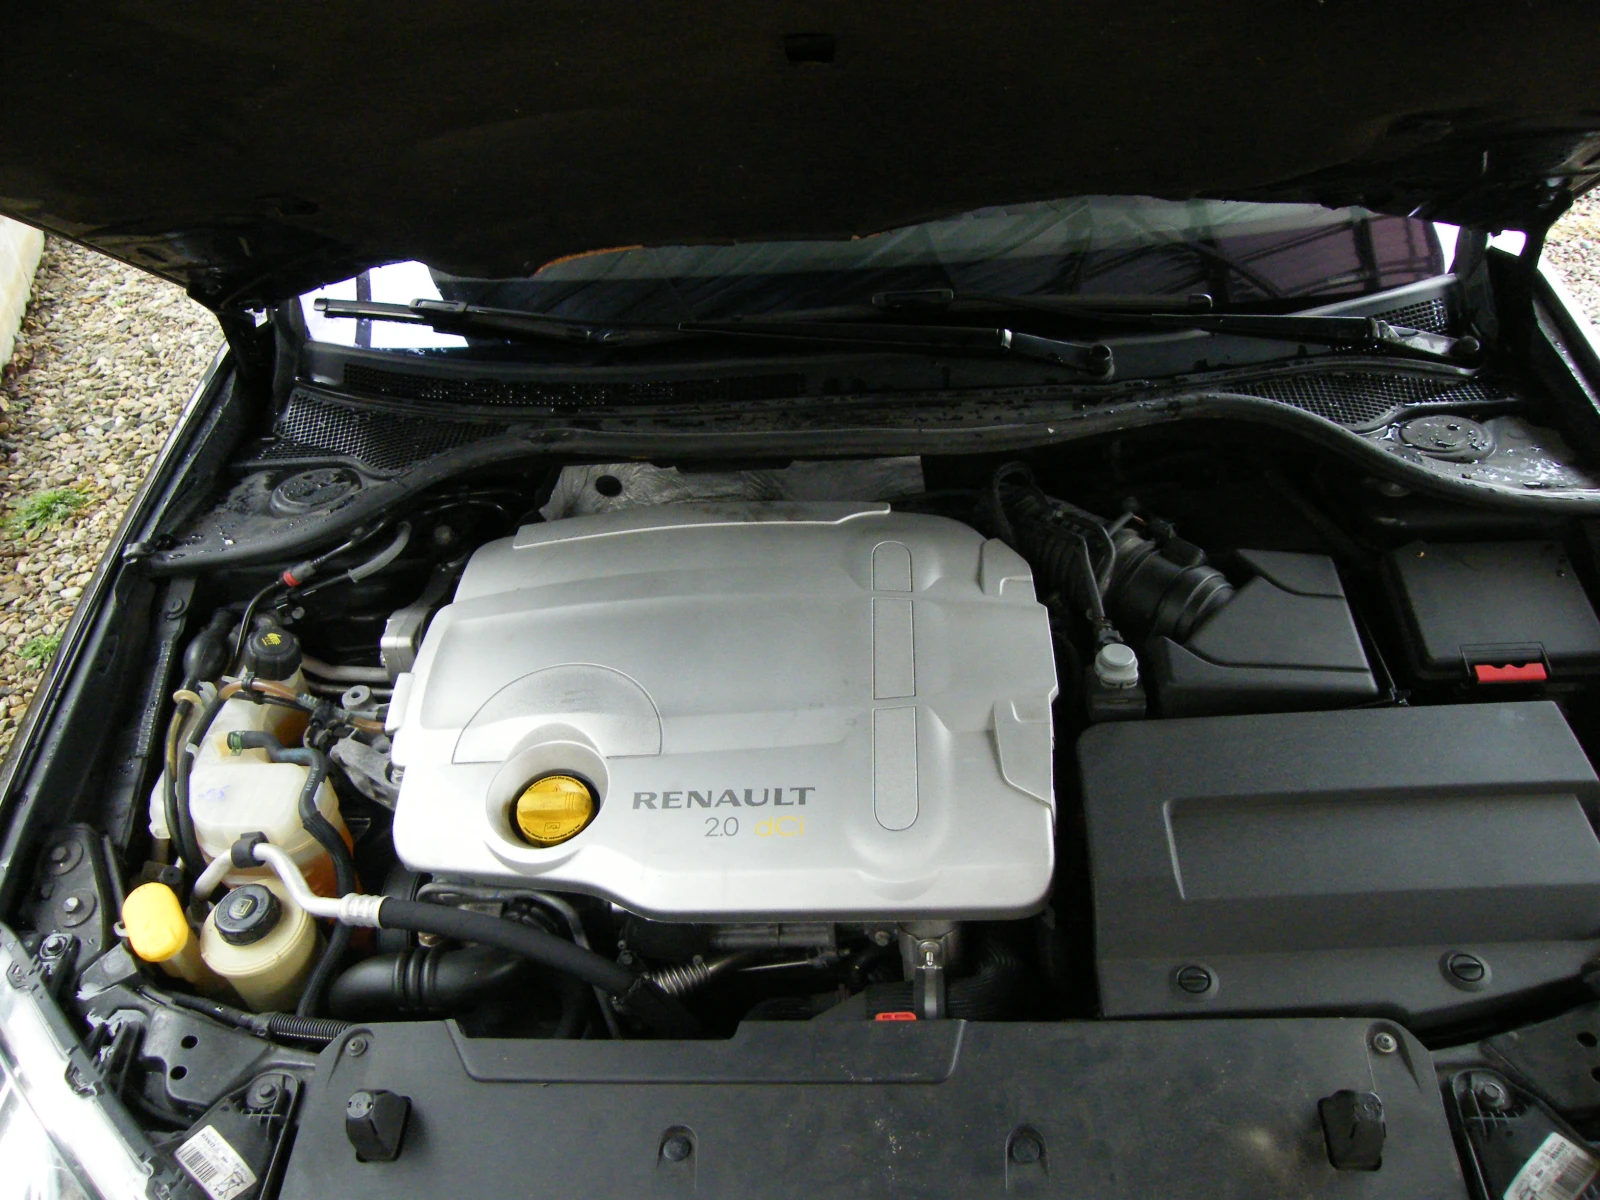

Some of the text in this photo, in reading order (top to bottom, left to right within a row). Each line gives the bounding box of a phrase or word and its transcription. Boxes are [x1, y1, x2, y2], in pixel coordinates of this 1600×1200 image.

[632, 787, 816, 809] RENAULT
[704, 815, 805, 837] 2.0 dCi
